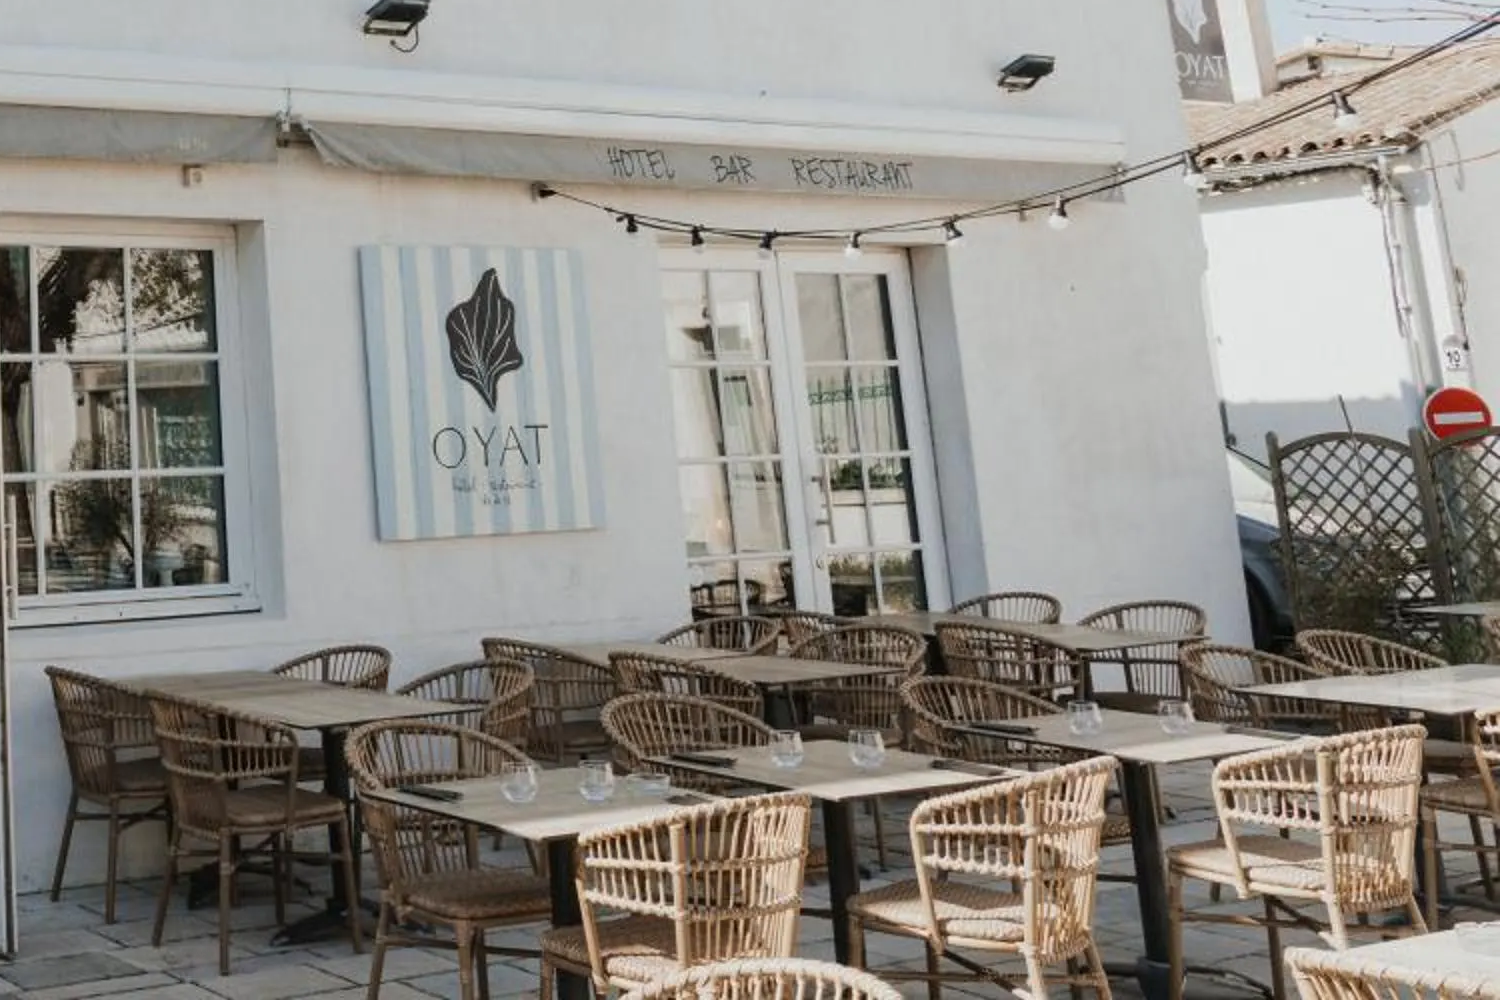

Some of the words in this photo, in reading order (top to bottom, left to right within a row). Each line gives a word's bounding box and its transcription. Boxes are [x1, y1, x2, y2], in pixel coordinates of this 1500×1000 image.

[1175, 51, 1225, 79] OYAT
[607, 147, 676, 179] HOTEL
[710, 154, 757, 184] BAR
[789, 158, 914, 190] RESTAURANT
[432, 424, 549, 469] OYAT
